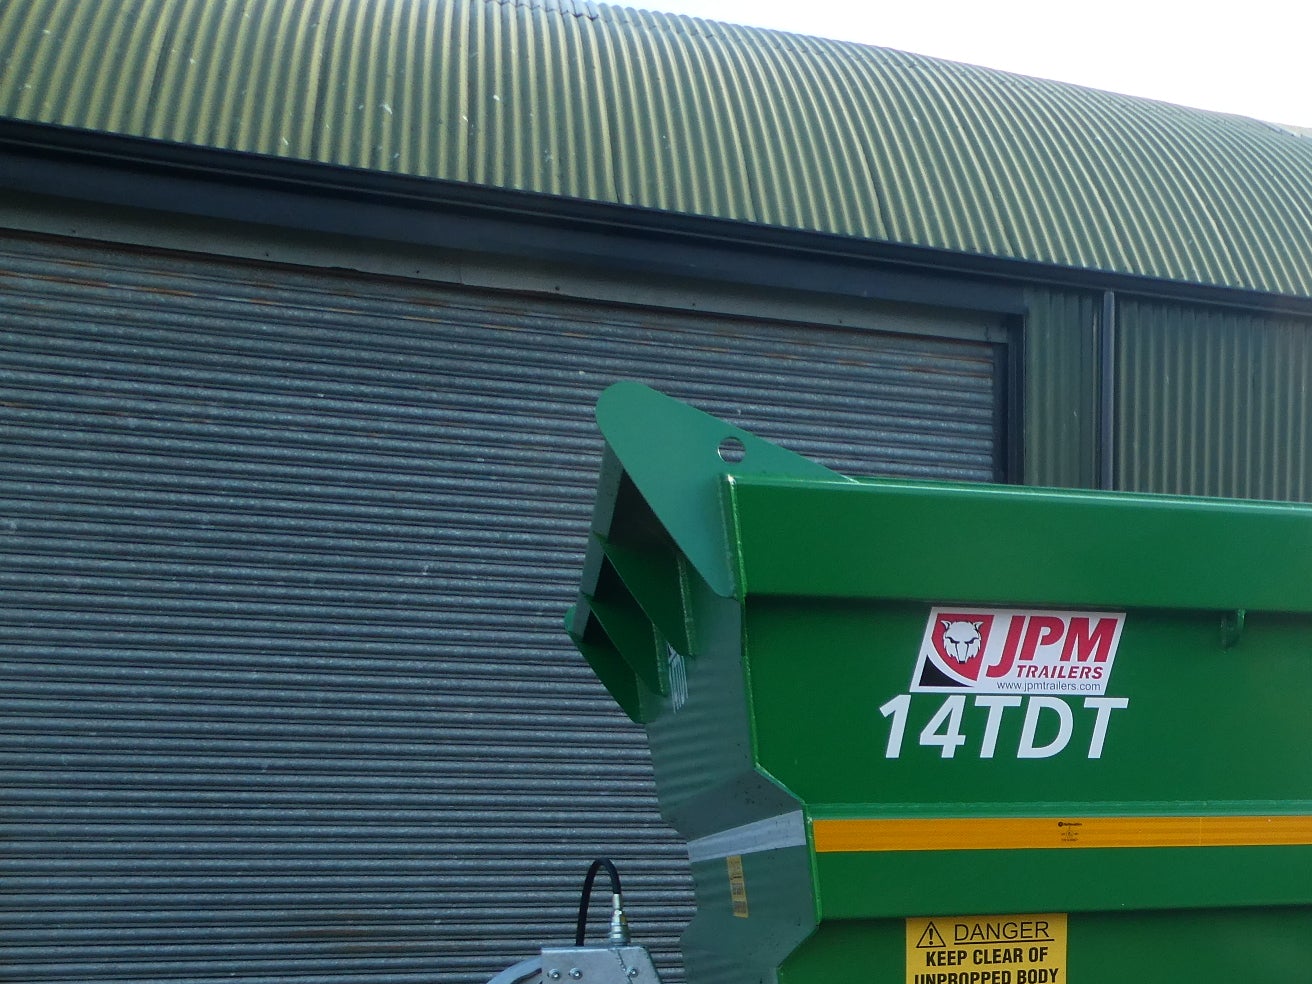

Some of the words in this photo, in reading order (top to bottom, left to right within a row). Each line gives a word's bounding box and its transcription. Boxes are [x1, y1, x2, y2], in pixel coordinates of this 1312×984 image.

[986, 615, 1118, 677] JPM
[1017, 665, 1103, 679] TRAILERS
[996, 681, 1101, 691] www.jpmtrailers.com
[879, 694, 1129, 759] 14TDT
[954, 921, 1050, 941] DANGER
[926, 949, 967, 967] KEEP
[973, 947, 1023, 965] CLEAR
[1028, 947, 1048, 963] OF
[1016, 968, 1059, 984] BODY
